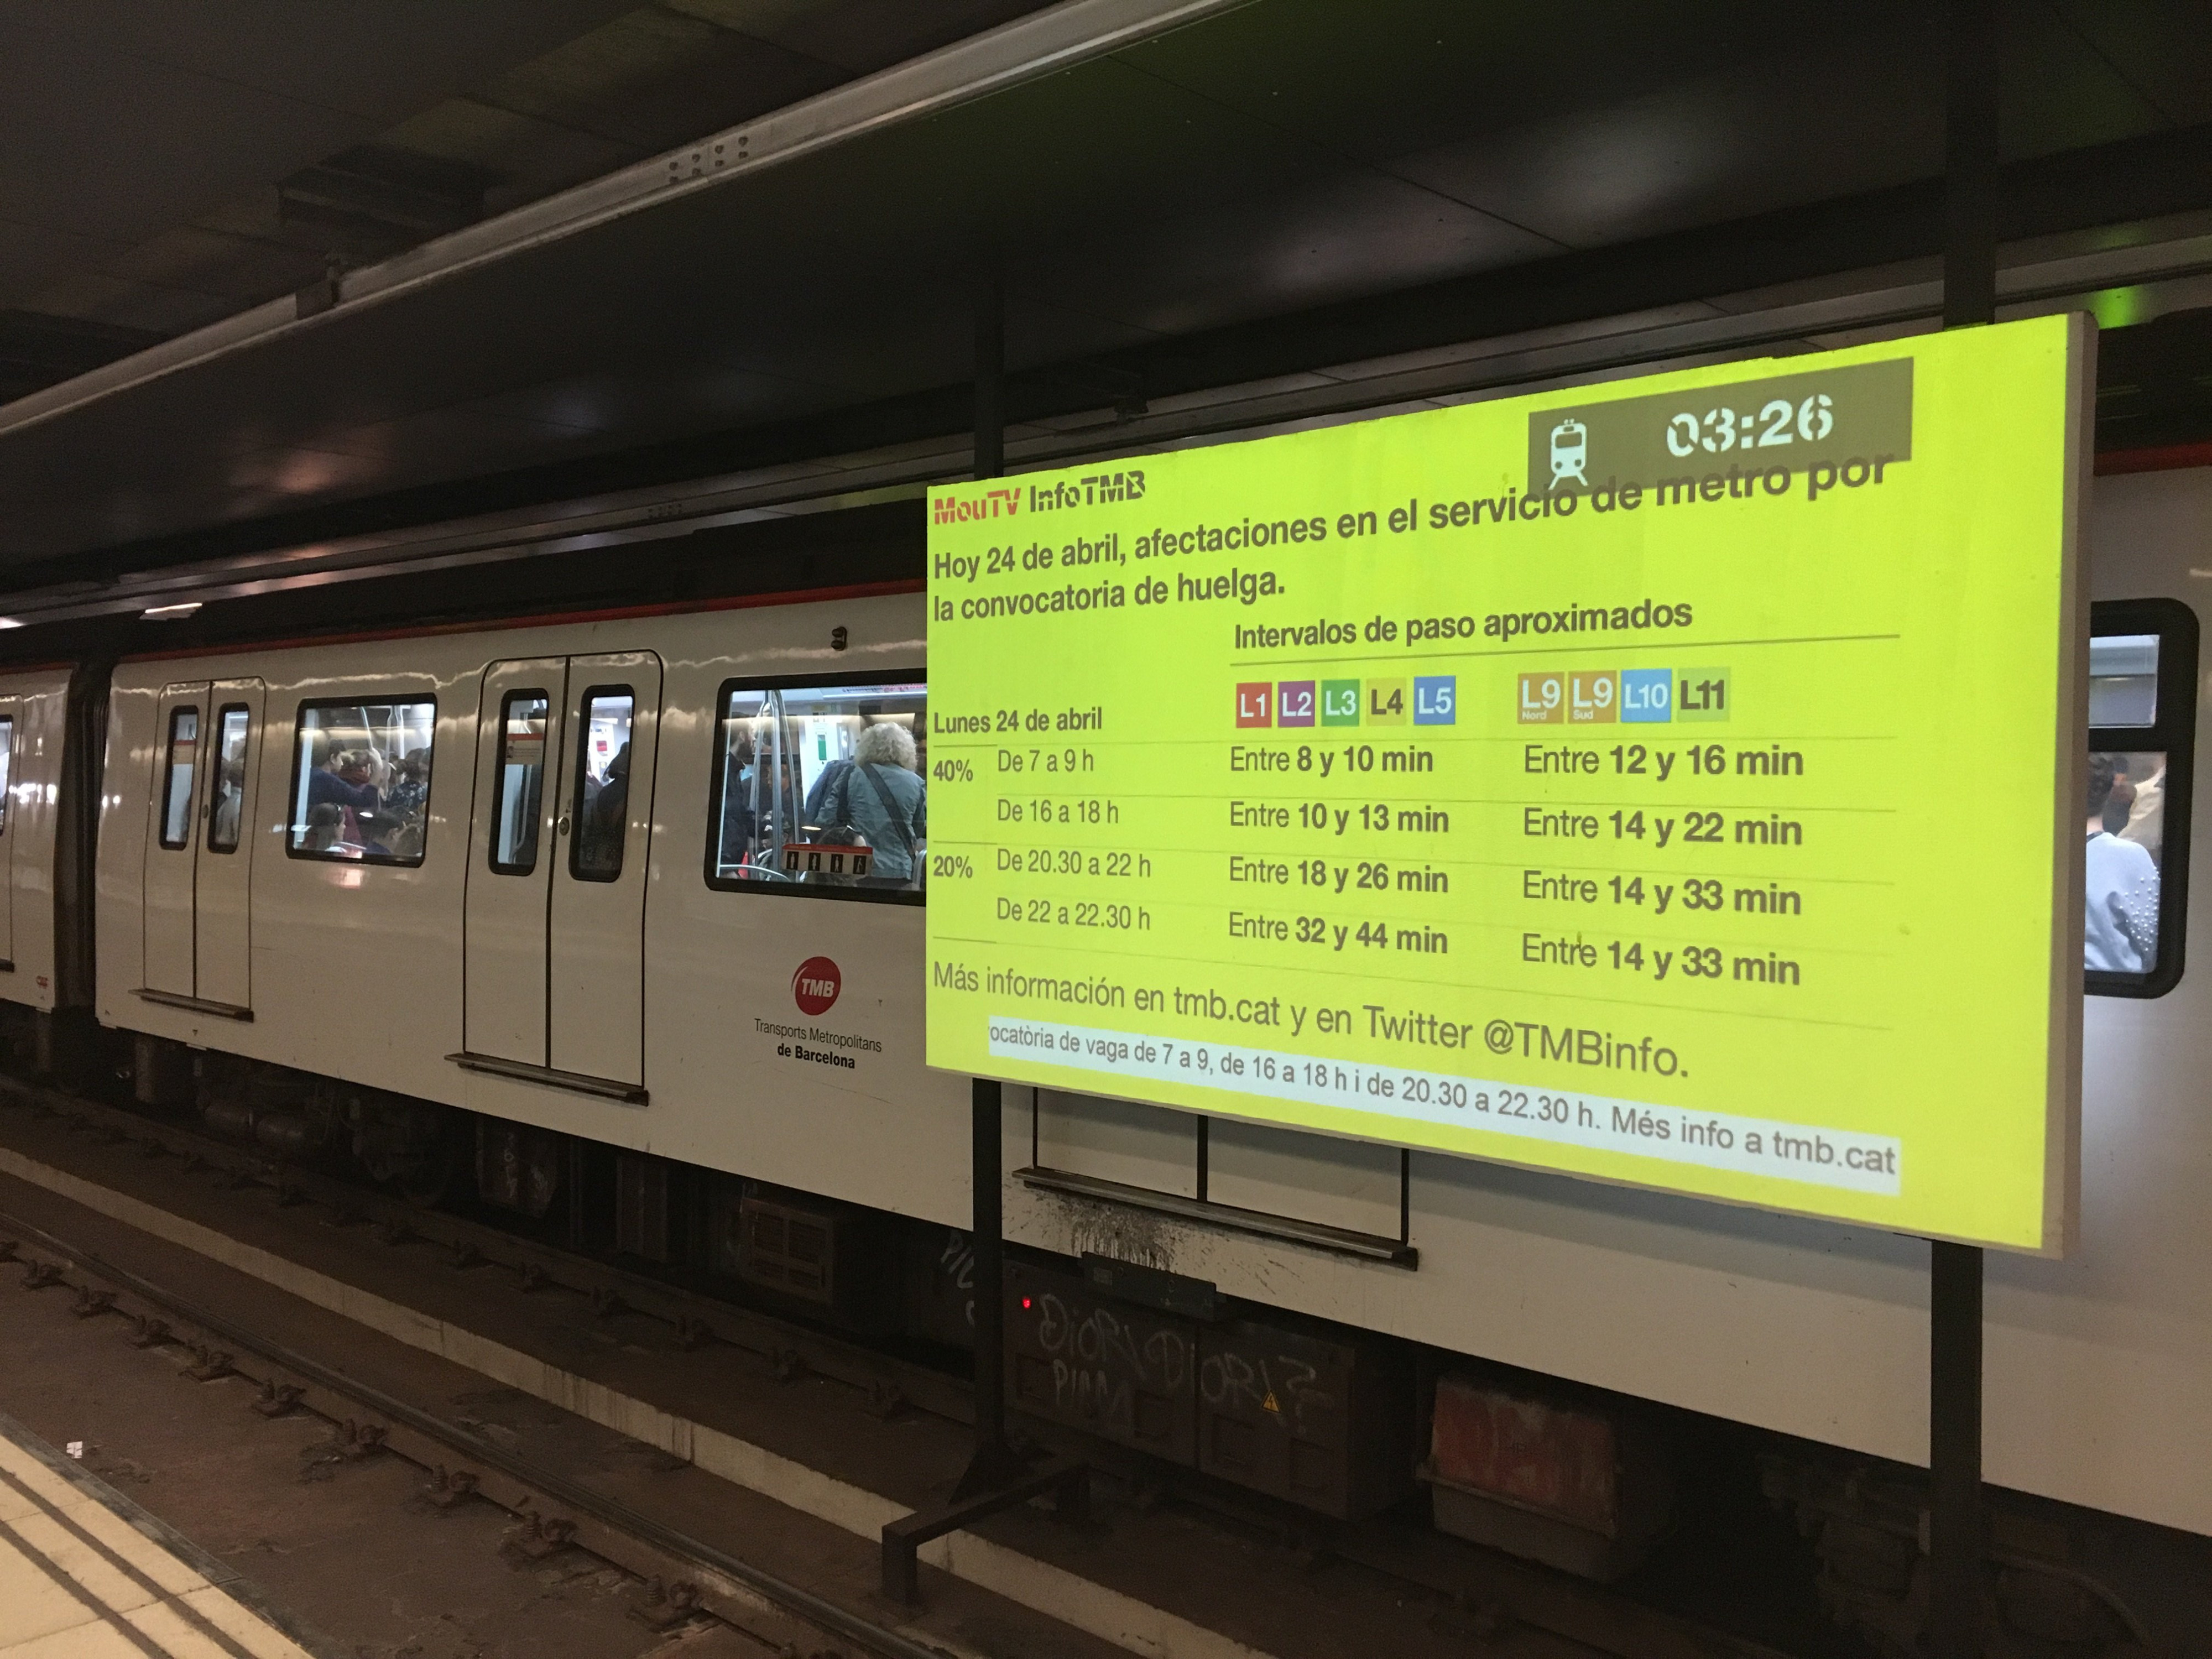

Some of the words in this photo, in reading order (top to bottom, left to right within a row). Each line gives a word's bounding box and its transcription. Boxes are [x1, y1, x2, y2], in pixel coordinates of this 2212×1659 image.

[1667, 394, 1834, 457] 03:26
[935, 488, 1021, 524] MouTV
[1030, 471, 1145, 512] InfoTMB
[935, 552, 980, 583] Hoy
[987, 546, 1015, 574] 24
[1022, 542, 1053, 571] de
[1062, 533, 1125, 566] abril,
[1135, 517, 1327, 559] afectaciones
[1337, 512, 1376, 539] en
[1388, 498, 1417, 533] el
[1429, 487, 1578, 529] servicio
[1591, 476, 1643, 513] de
[1657, 462, 1791, 505] metro
[1807, 453, 1894, 501] por
[935, 596, 953, 621] la
[961, 580, 1125, 619] convocatoria
[1135, 576, 1168, 605] de
[1178, 567, 1285, 605] huelga.
[1235, 619, 1357, 649] Intervalos
[1364, 615, 1397, 643] de
[1406, 616, 1475, 646] paso
[1484, 598, 1692, 642] aproximados
[1240, 693, 1266, 717] L1
[1282, 691, 1312, 717] L2
[1326, 690, 1356, 716] L3
[1371, 688, 1404, 716] L4
[1418, 687, 1452, 714] L5
[1522, 679, 1561, 709] L9
[1573, 677, 1613, 708] L9
[1624, 684, 1668, 709] L10
[1680, 679, 1724, 710] L11
[935, 712, 990, 733] Lunes
[997, 710, 1019, 732] 24
[1026, 709, 1049, 732] de
[1057, 707, 1102, 731] abril
[1522, 709, 1547, 720] Nord
[1573, 709, 1593, 719] Sud
[933, 759, 973, 781] 40%
[999, 750, 1022, 772] De
[1030, 750, 1040, 771] 7
[1047, 754, 1058, 772] a
[1065, 749, 1076, 772] 9
[1083, 749, 1093, 771] h
[1231, 746, 1290, 771] Entre
[1297, 745, 1312, 771] 8
[1319, 752, 1334, 778] y
[1344, 745, 1374, 771] 10
[1383, 745, 1433, 772] min
[1525, 745, 1599, 774] Entre
[1610, 745, 1646, 774] 12
[1656, 752, 1675, 781] y
[1687, 744, 1726, 775] 16
[1736, 744, 1803, 775] min
[998, 799, 1022, 822] De
[1030, 800, 1052, 822] 16
[1059, 805, 1070, 822] a
[1078, 800, 1100, 823] 18
[1108, 800, 1118, 823] h
[1231, 801, 1289, 827] Entre
[1299, 803, 1327, 829] 10
[1334, 810, 1349, 835] y
[1359, 804, 1389, 831] 13
[1398, 805, 1448, 832] min
[1525, 807, 1599, 838] Entre
[1609, 810, 1646, 839] 14
[1655, 818, 1674, 848] y
[1683, 812, 1724, 842] 22
[1735, 813, 1802, 845] min
[934, 855, 973, 878] 20%
[998, 849, 1022, 872] De
[1029, 850, 1081, 874] 20.30
[1088, 857, 1100, 875] a
[1107, 852, 1131, 876] 22
[1139, 854, 1150, 877] h
[1230, 856, 1288, 884] Entre
[1298, 860, 1326, 886] 18
[1334, 868, 1349, 894] y
[1357, 862, 1389, 890] 26
[1397, 865, 1448, 893] min
[1524, 870, 1598, 903] Entre
[1608, 875, 1645, 905] 14
[1654, 885, 1673, 915] y
[1682, 879, 1723, 911] 33
[1734, 883, 1801, 915] min
[998, 898, 1022, 921] De
[1028, 900, 1050, 922] 22
[1058, 907, 1069, 925] a
[1076, 903, 1131, 929] 22.30
[1139, 906, 1150, 930] h
[1229, 912, 1288, 941] Entre
[1296, 916, 1325, 943] 32
[1333, 926, 1348, 951] y
[1356, 922, 1388, 948] 44
[1397, 926, 1447, 953] min
[1523, 933, 1597, 968] Entre
[1608, 941, 1644, 971] 14
[1653, 951, 1673, 980] y
[1682, 946, 1723, 978] 33
[1734, 952, 1799, 985] min
[802, 978, 835, 998] TMB
[754, 1018, 807, 1040] Transports
[809, 1027, 883, 1053] Metropolitans
[935, 962, 978, 992] Más
[988, 967, 1124, 1007] información
[1135, 989, 1164, 1011] en
[1174, 987, 1280, 1026] tmb.cat
[1291, 1005, 1306, 1036] y
[1317, 1009, 1351, 1034] en
[1363, 1005, 1473, 1048] Twitter
[1484, 1019, 1688, 1077] @TMBinfo.
[777, 1042, 791, 1057] de
[795, 1045, 855, 1070] Barcelona
[988, 1025, 1054, 1049] ocatòria
[1060, 1031, 1079, 1052] de
[1086, 1039, 1128, 1062] vaga
[1135, 1041, 1156, 1063] de
[1163, 1044, 1173, 1064] 7
[1180, 1051, 1190, 1067] a
[1198, 1048, 1213, 1074] 9,
[1221, 1052, 1244, 1075] de
[1254, 1056, 1275, 1079] 16
[1283, 1066, 1294, 1083] a
[1304, 1063, 1327, 1087] 18
[1335, 1067, 1347, 1091] h
[1354, 1069, 1360, 1093] i
[1368, 1072, 1394, 1097] de
[1402, 1077, 1467, 1108] 20.30
[1475, 1093, 1489, 1112] a
[1498, 1090, 1568, 1123] 22.30
[1578, 1101, 1600, 1129] h.
[1613, 1106, 1670, 1139] Més
[1682, 1116, 1733, 1149] info
[1745, 1133, 1762, 1154] a
[1773, 1132, 1895, 1174] tmb.cat
